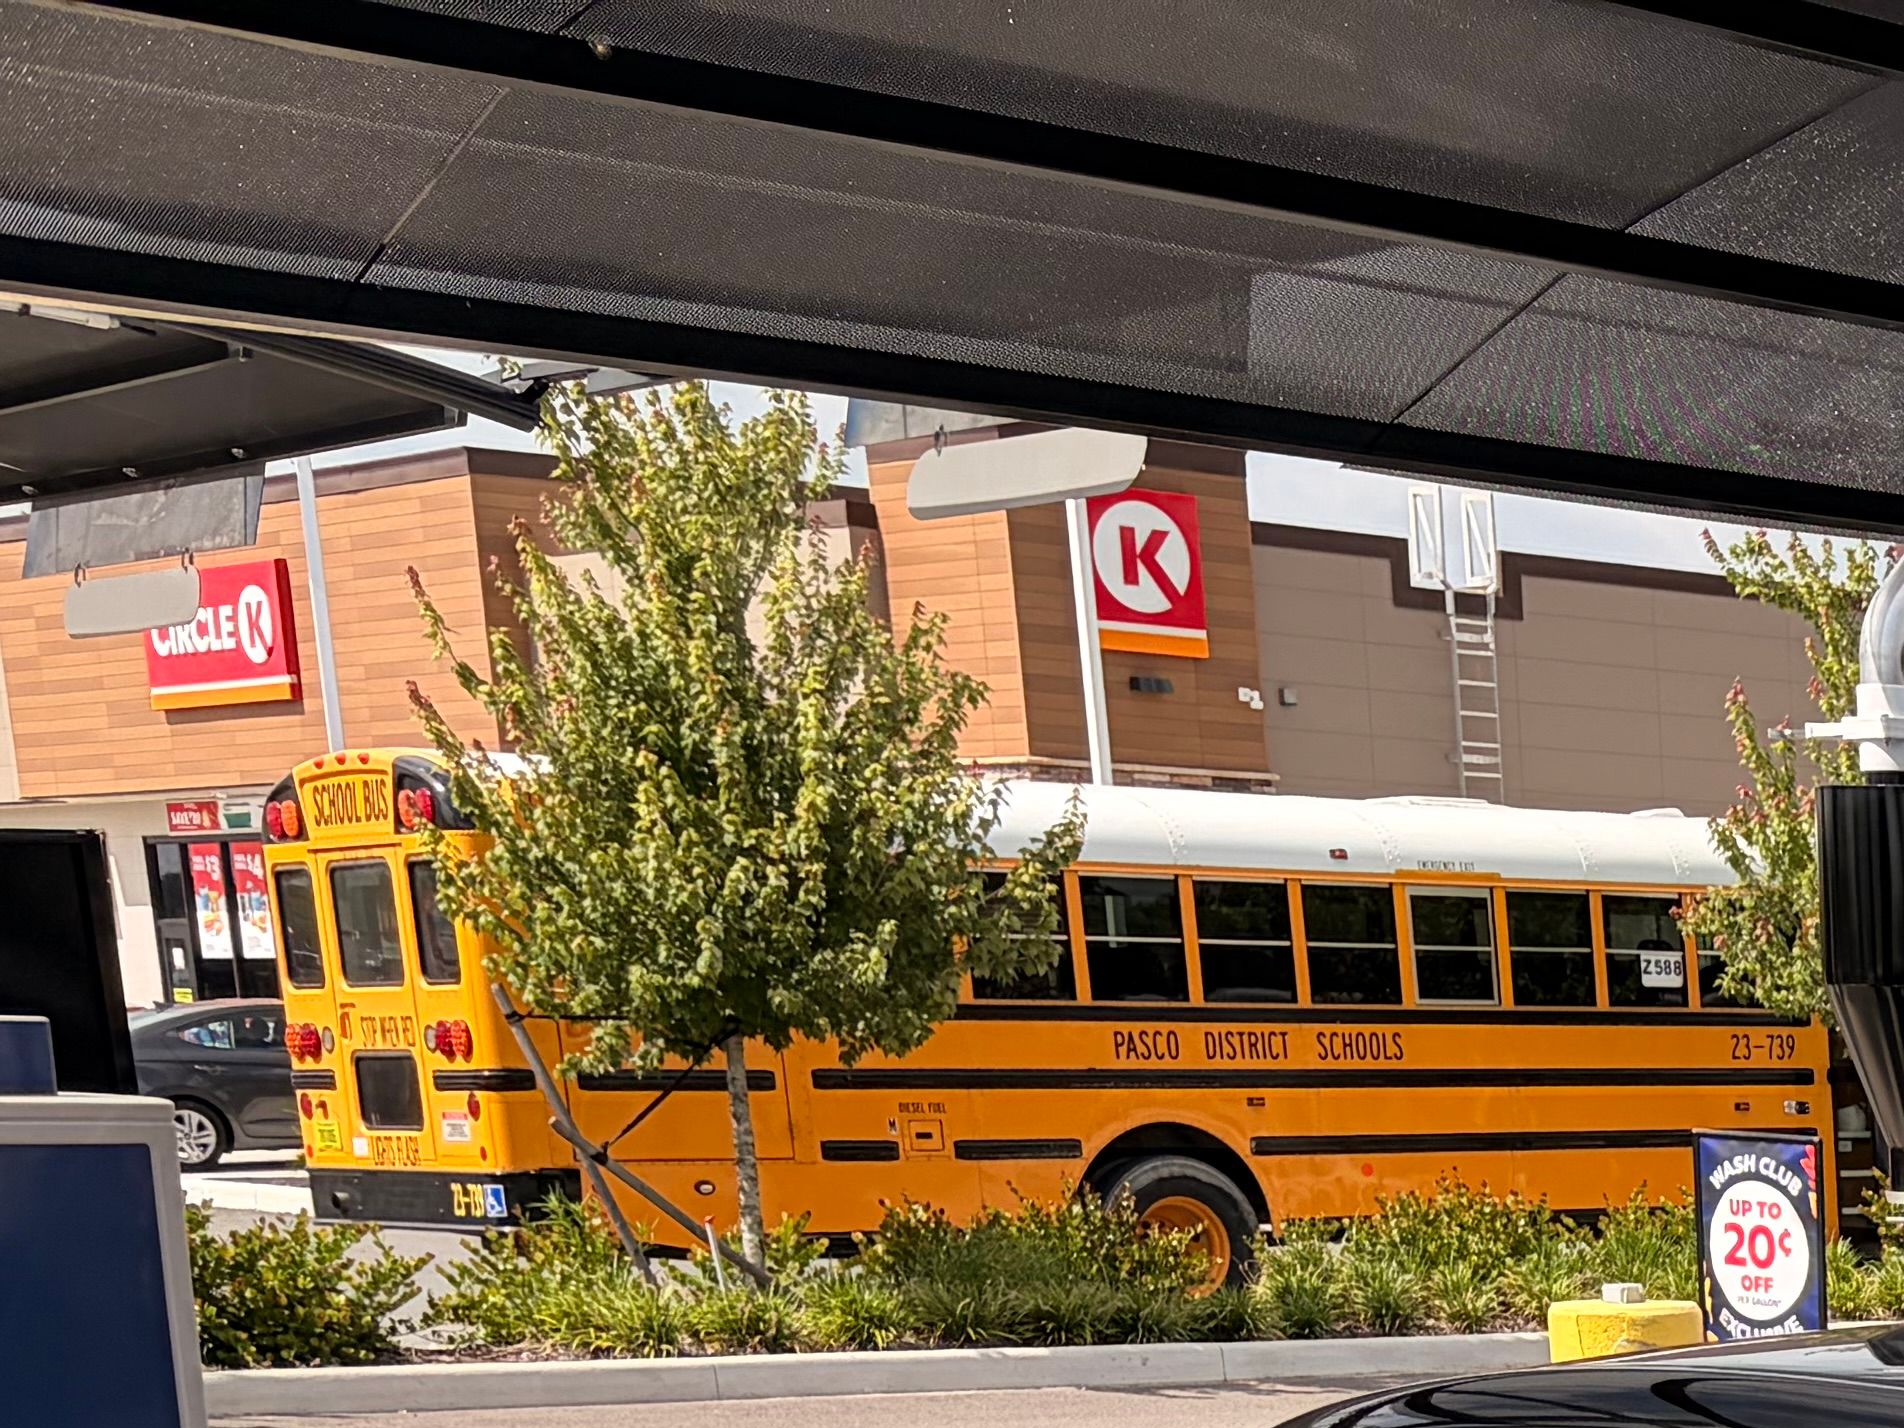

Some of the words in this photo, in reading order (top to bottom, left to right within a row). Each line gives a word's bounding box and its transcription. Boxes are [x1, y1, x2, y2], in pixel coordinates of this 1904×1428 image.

[313, 781, 361, 828] SCHOOL
[363, 778, 389, 823] BUS
[1113, 1031, 1180, 1061] PASCO
[1204, 1031, 1289, 1061] DISTRICT
[1317, 1031, 1405, 1062] SCHOOLS
[1730, 1034, 1796, 1060] 23-739
[1709, 1154, 1756, 1190] WASH
[1759, 1157, 1803, 1197] CLUB
[1729, 1199, 1752, 1217] UP
[1757, 1201, 1782, 1220] TO
[1724, 1222, 1792, 1269] 20¢
[1741, 1275, 1774, 1294] OFF
